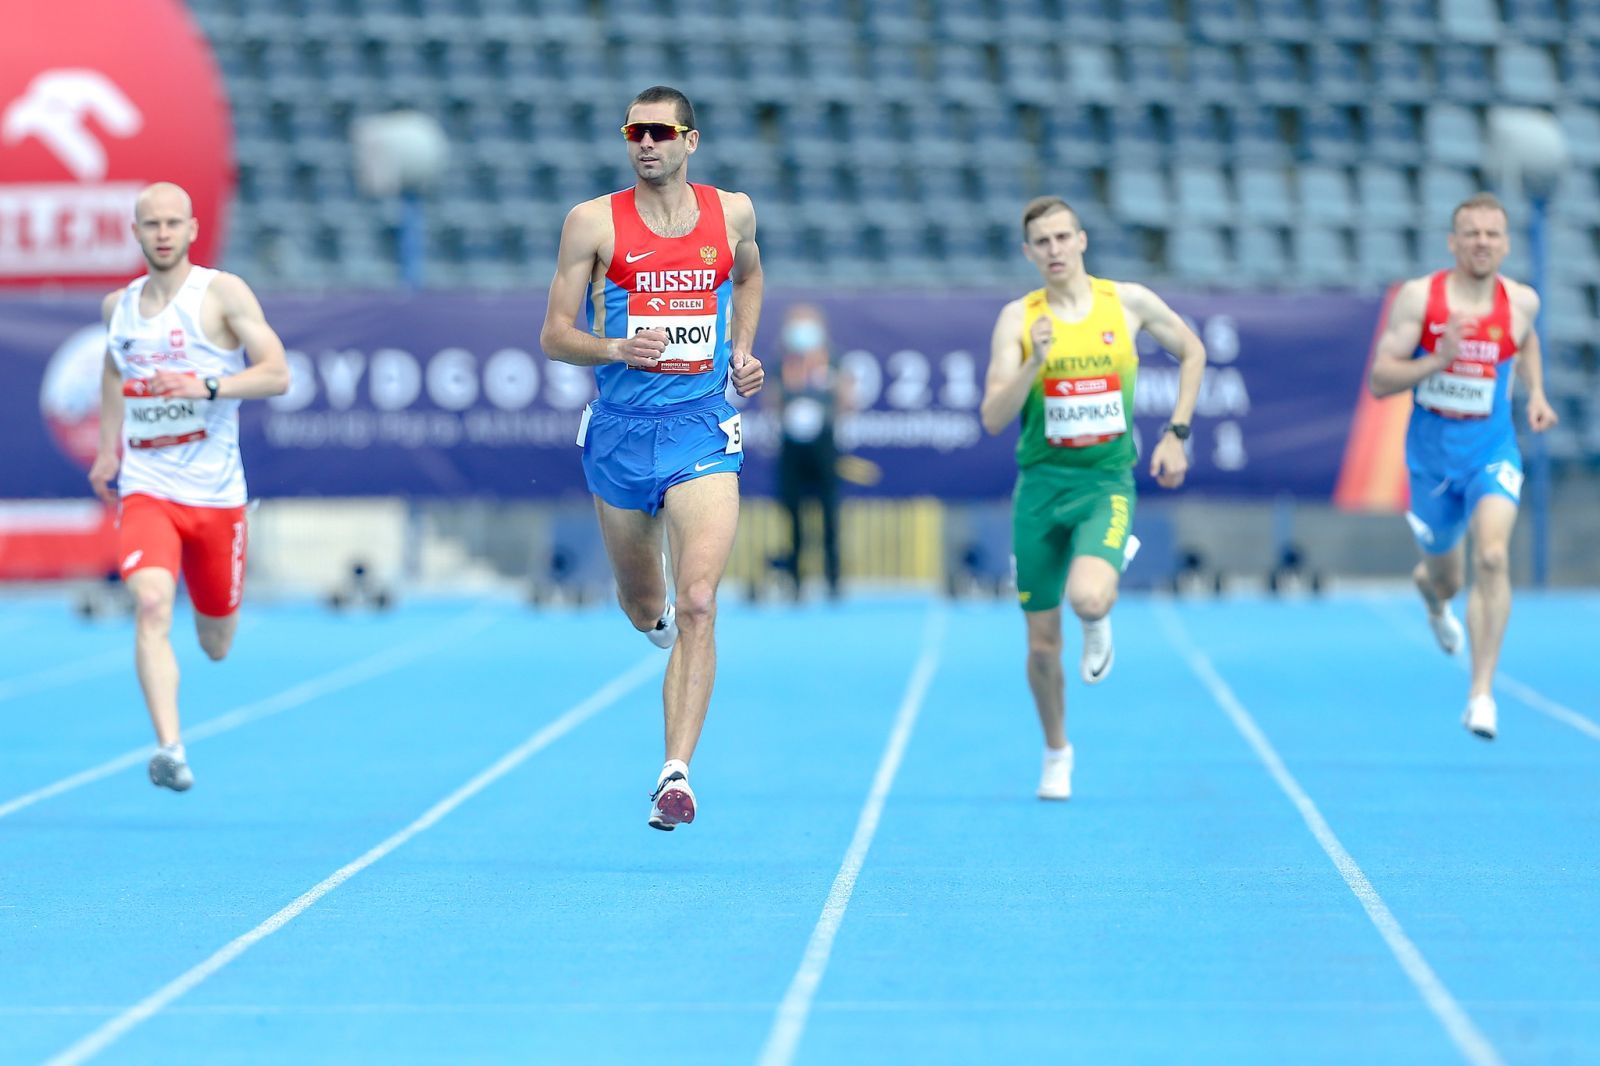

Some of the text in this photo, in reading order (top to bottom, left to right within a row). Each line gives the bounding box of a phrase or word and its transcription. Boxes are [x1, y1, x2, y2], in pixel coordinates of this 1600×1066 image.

[636, 269, 716, 292] RUSSIA
[1048, 401, 1121, 422] KRAPIKAS
[733, 422, 741, 446] 5
